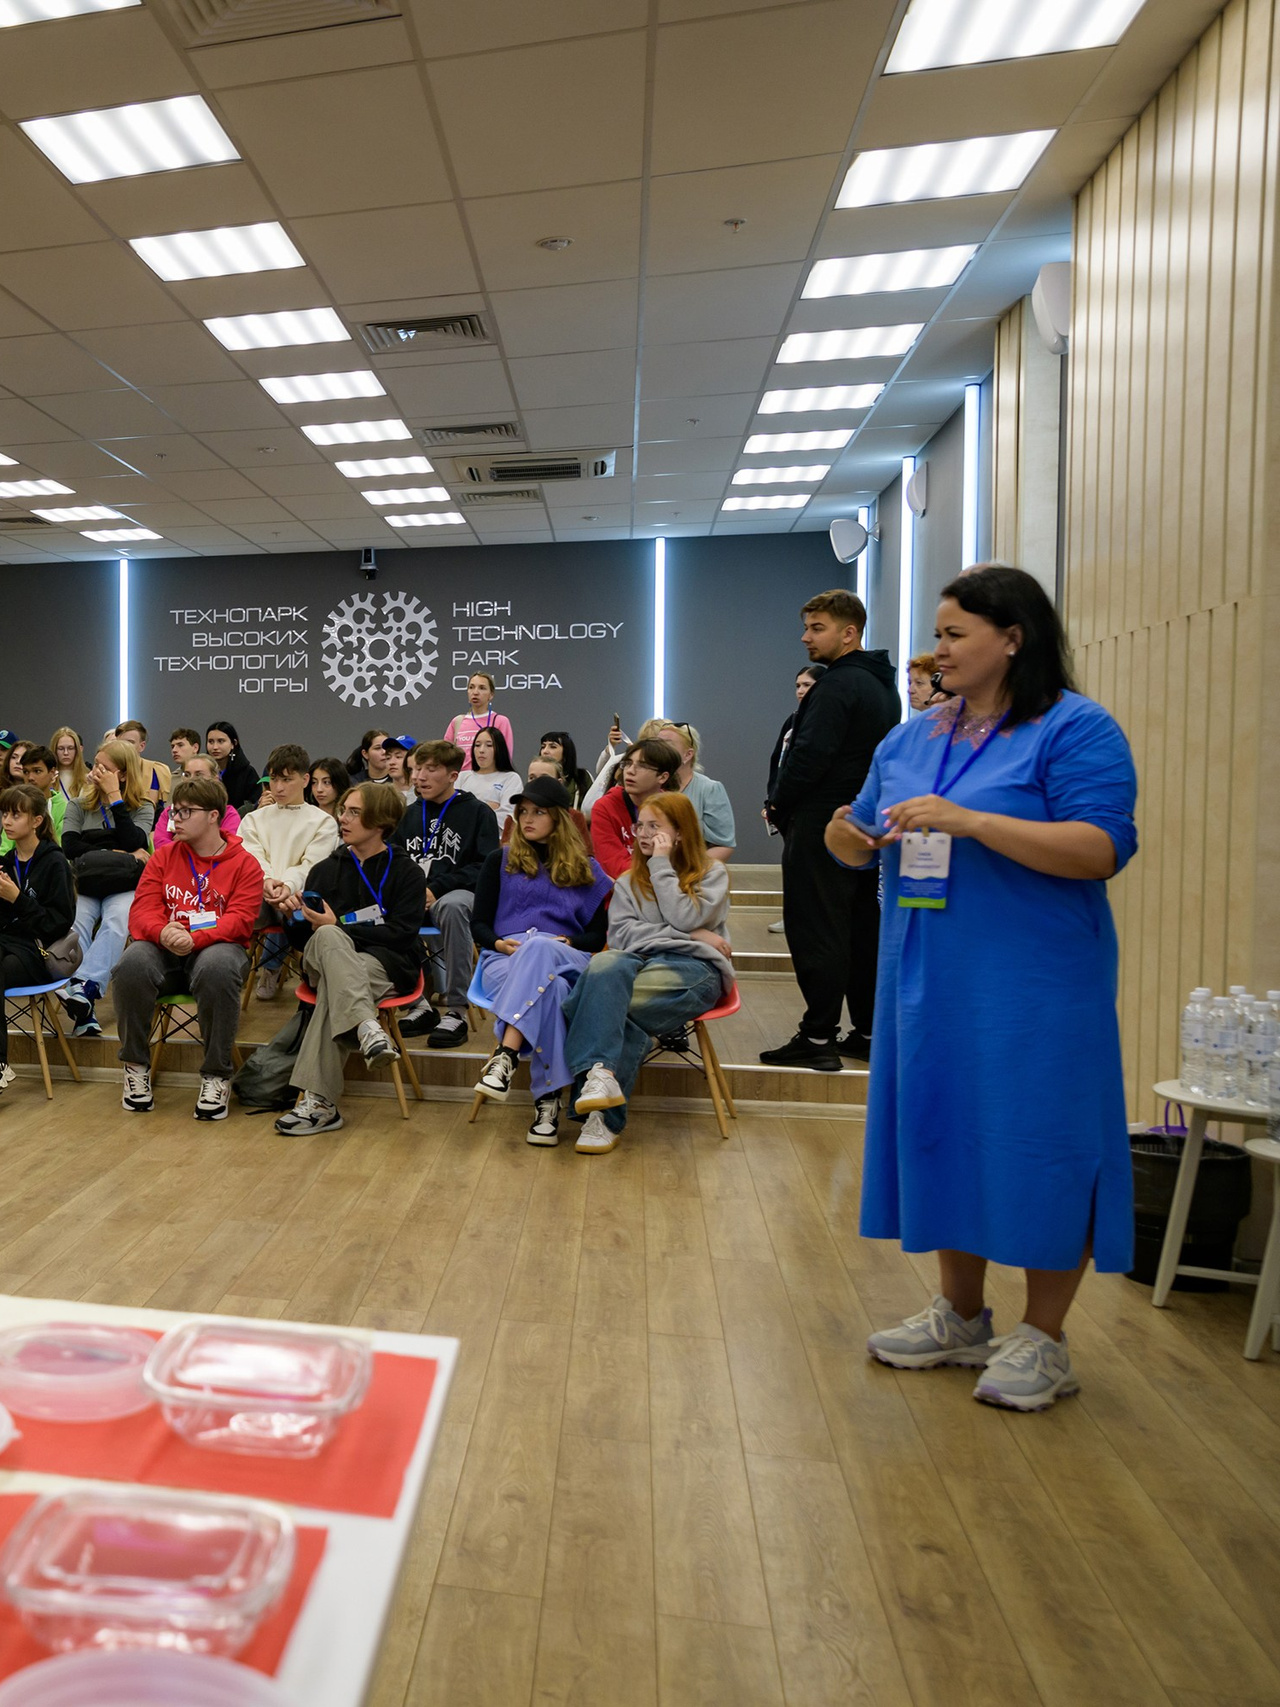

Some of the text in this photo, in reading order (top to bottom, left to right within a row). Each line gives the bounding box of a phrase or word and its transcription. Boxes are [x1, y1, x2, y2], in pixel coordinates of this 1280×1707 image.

[170, 606, 308, 624] ТЕХНОПАРК
[452, 600, 511, 617] HIGH
[192, 630, 309, 647] ВЫСОКИХ
[452, 622, 624, 642] TECHNOLOGY
[153, 650, 308, 671] ТЕХНОЛОГИЙ
[452, 650, 519, 666] PARK
[238, 677, 308, 693] ЮГРЫ
[493, 673, 562, 690] UGRA
